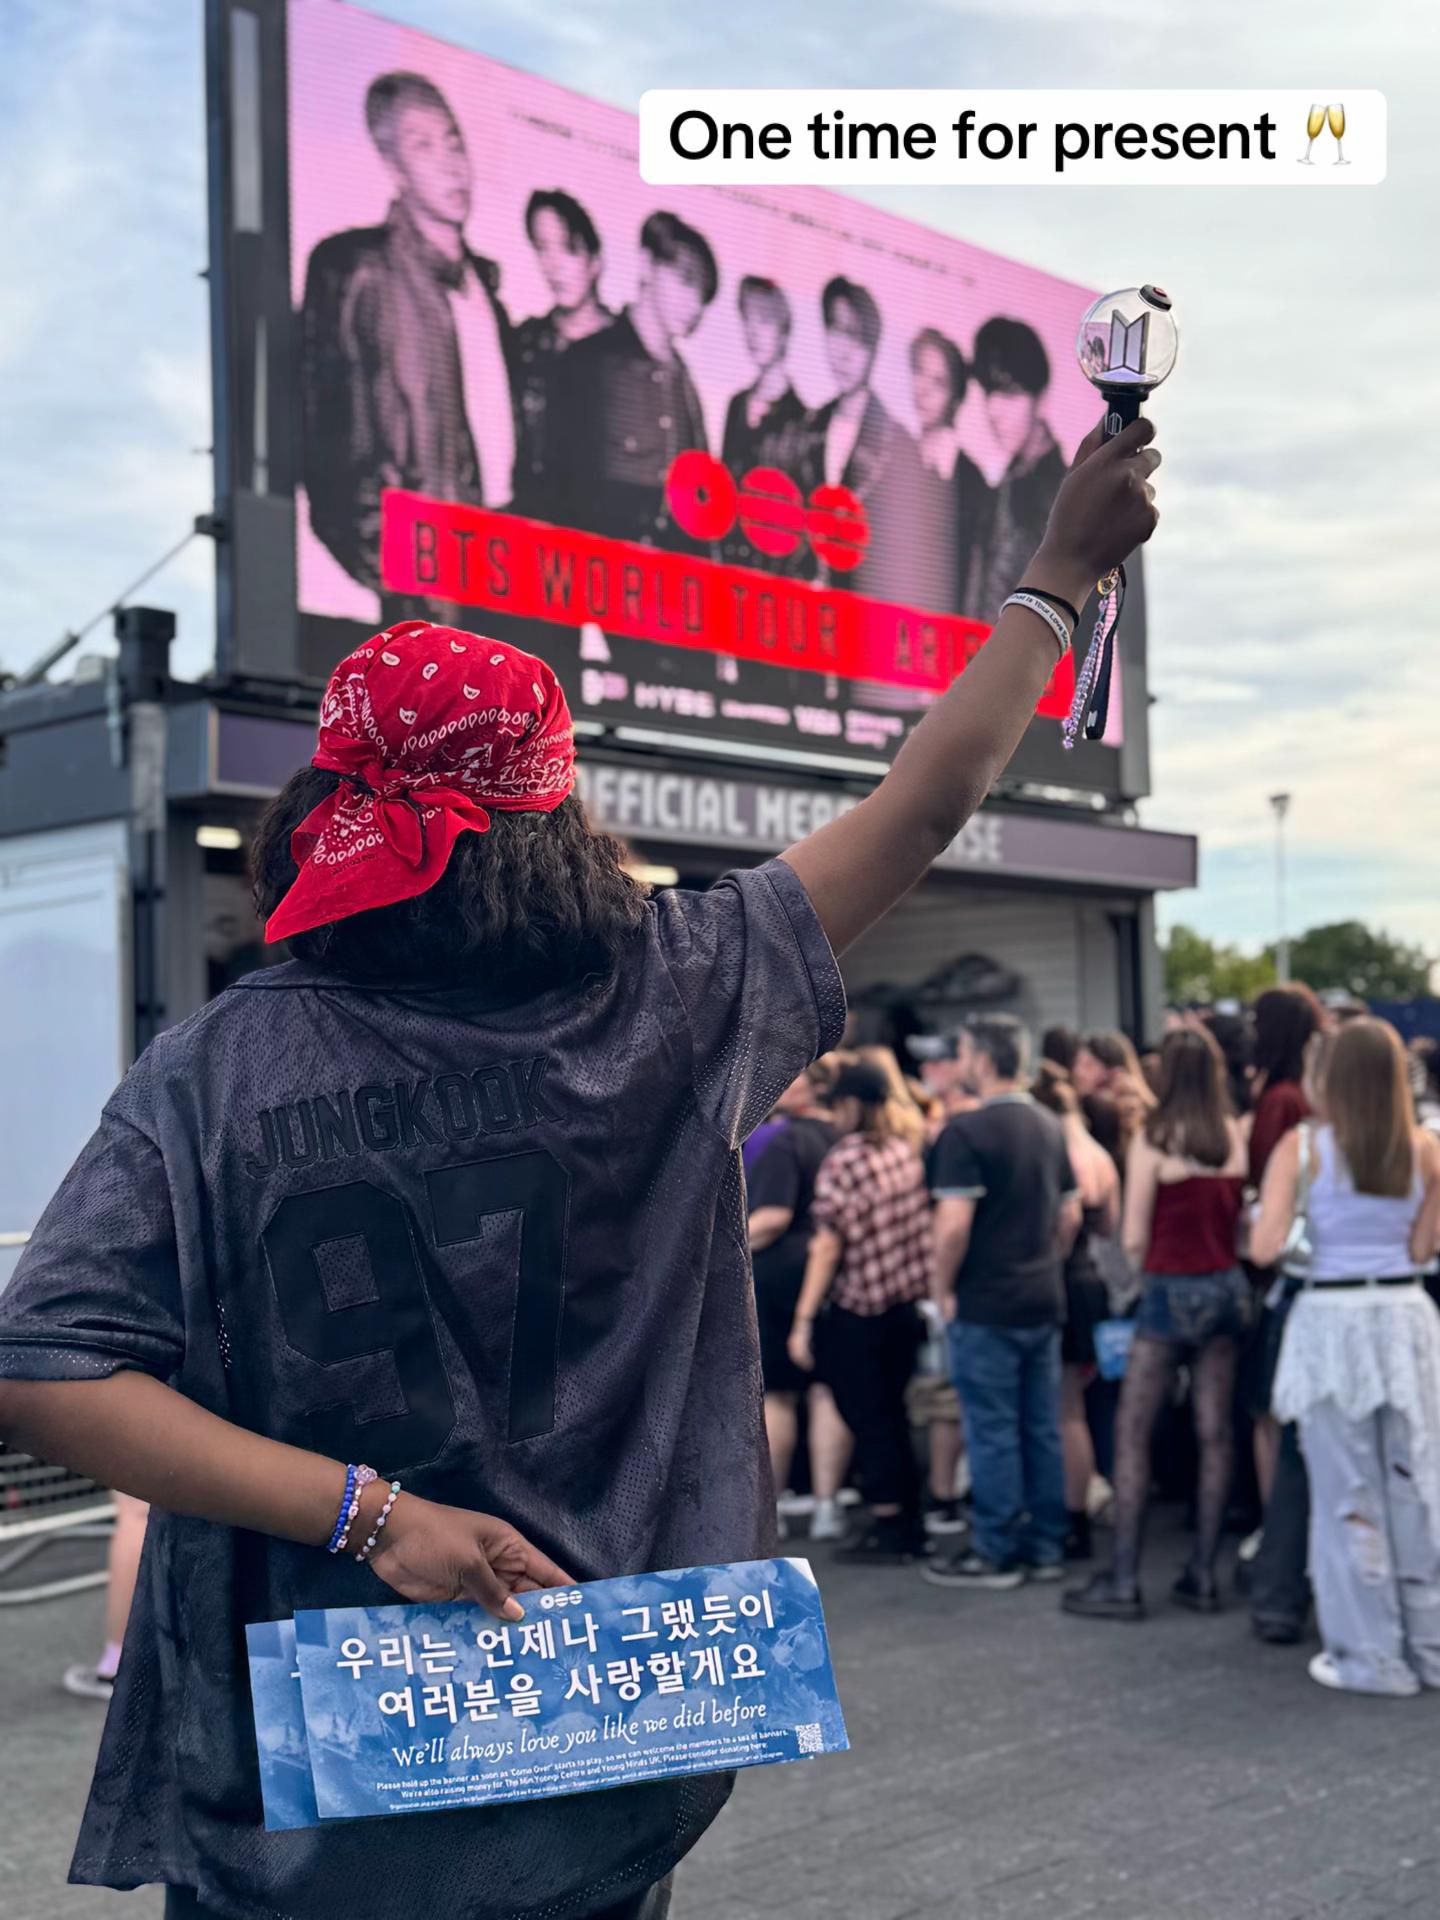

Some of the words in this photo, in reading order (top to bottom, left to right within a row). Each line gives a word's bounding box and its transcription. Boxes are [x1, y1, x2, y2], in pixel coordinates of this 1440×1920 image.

[414, 520, 511, 597] BTS
[537, 544, 704, 634] WORLD
[732, 585, 838, 659] TOUR
[245, 1056, 565, 1180] JUNGKOOK
[259, 1148, 573, 1478] 97
[336, 1633, 457, 1680] 우리는
[476, 1612, 600, 1669] 언제나
[621, 1589, 775, 1642] 그랬듯이
[378, 1673, 543, 1728] 여러분을
[563, 1643, 766, 1705] 사랑할게요
[376, 1781, 400, 1791] Please
[401, 1779, 418, 1788] hold
[443, 1775, 469, 1784] banner
[481, 1772, 499, 1780] soon
[554, 1761, 576, 1770] starts
[628, 1750, 642, 1758] can
[643, 1745, 675, 1755] welcome
[689, 1738, 722, 1748] members
[391, 1737, 444, 1767] We'll
[450, 1735, 514, 1763] always
[520, 1728, 559, 1753] love
[559, 1728, 598, 1754] you
[602, 1712, 639, 1745] like
[643, 1717, 668, 1733] we
[673, 1701, 706, 1729] did
[712, 1695, 767, 1727] before
[424, 1788, 439, 1796] also
[440, 1785, 465, 1795] raising
[467, 1783, 491, 1793] money
[587, 1766, 601, 1775] and
[602, 1763, 625, 1773] Young
[626, 1758, 648, 1769] Minds
[663, 1753, 688, 1763] Please
[688, 1748, 718, 1759] consider
[720, 1743, 750, 1754] donating
